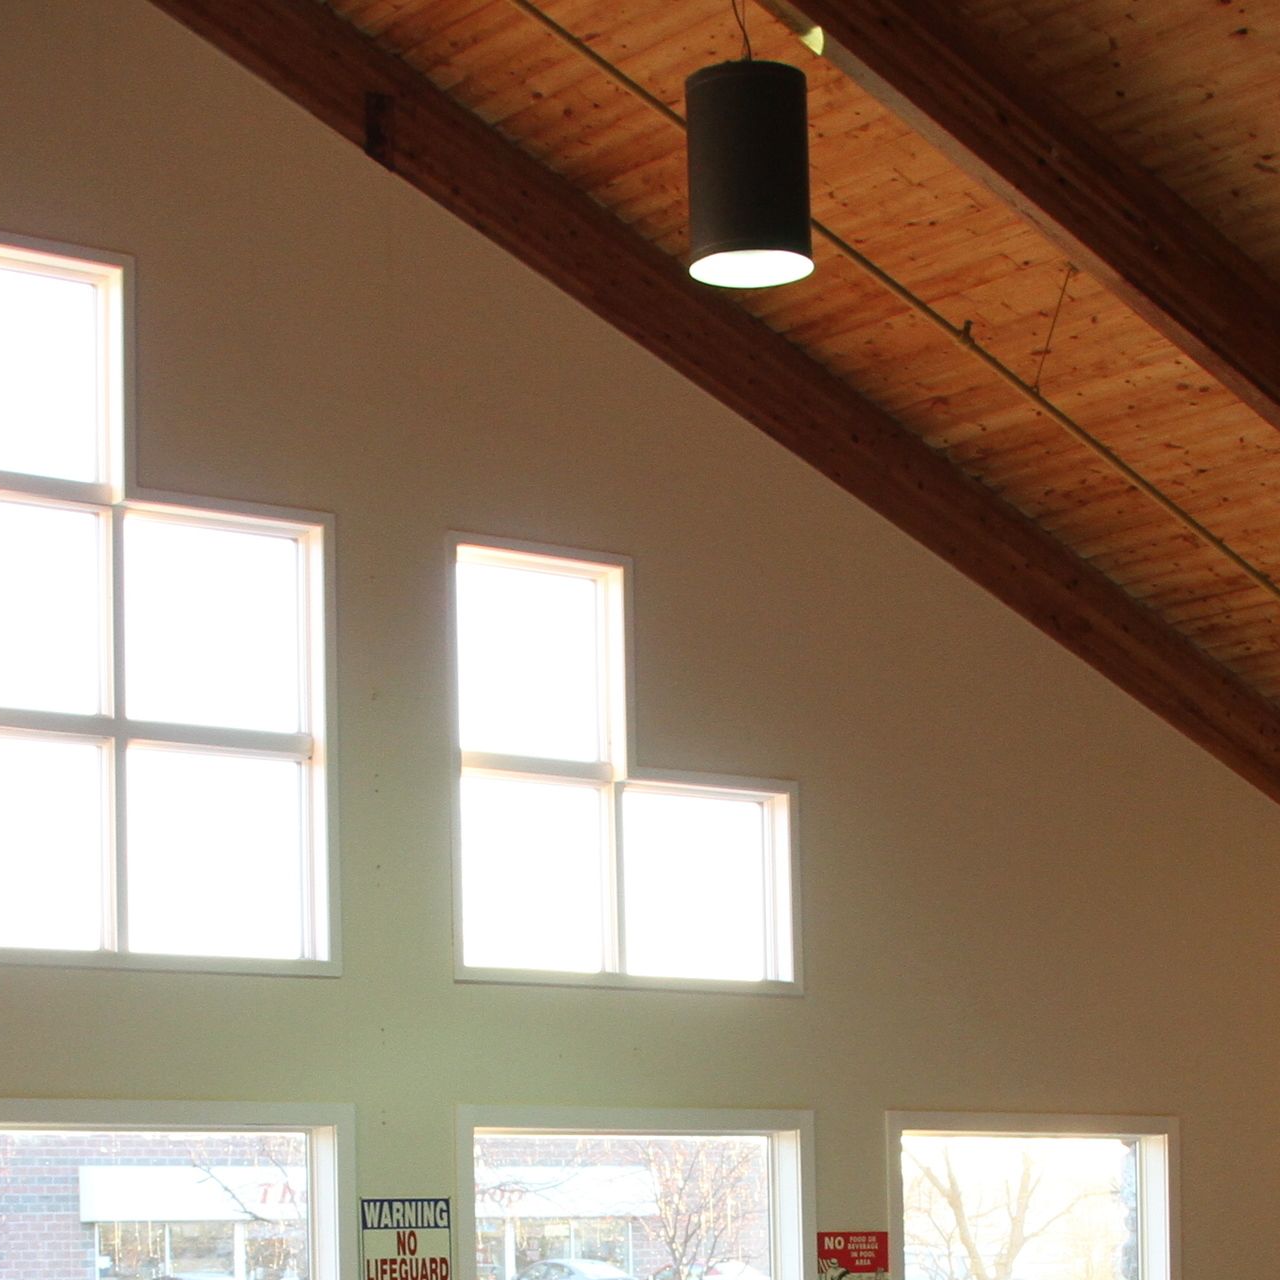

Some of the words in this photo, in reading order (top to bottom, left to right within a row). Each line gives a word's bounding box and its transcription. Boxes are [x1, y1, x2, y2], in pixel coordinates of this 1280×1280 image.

[363, 1200, 449, 1228] WARNING
[396, 1230, 417, 1256] NO
[824, 1236, 845, 1250] NO
